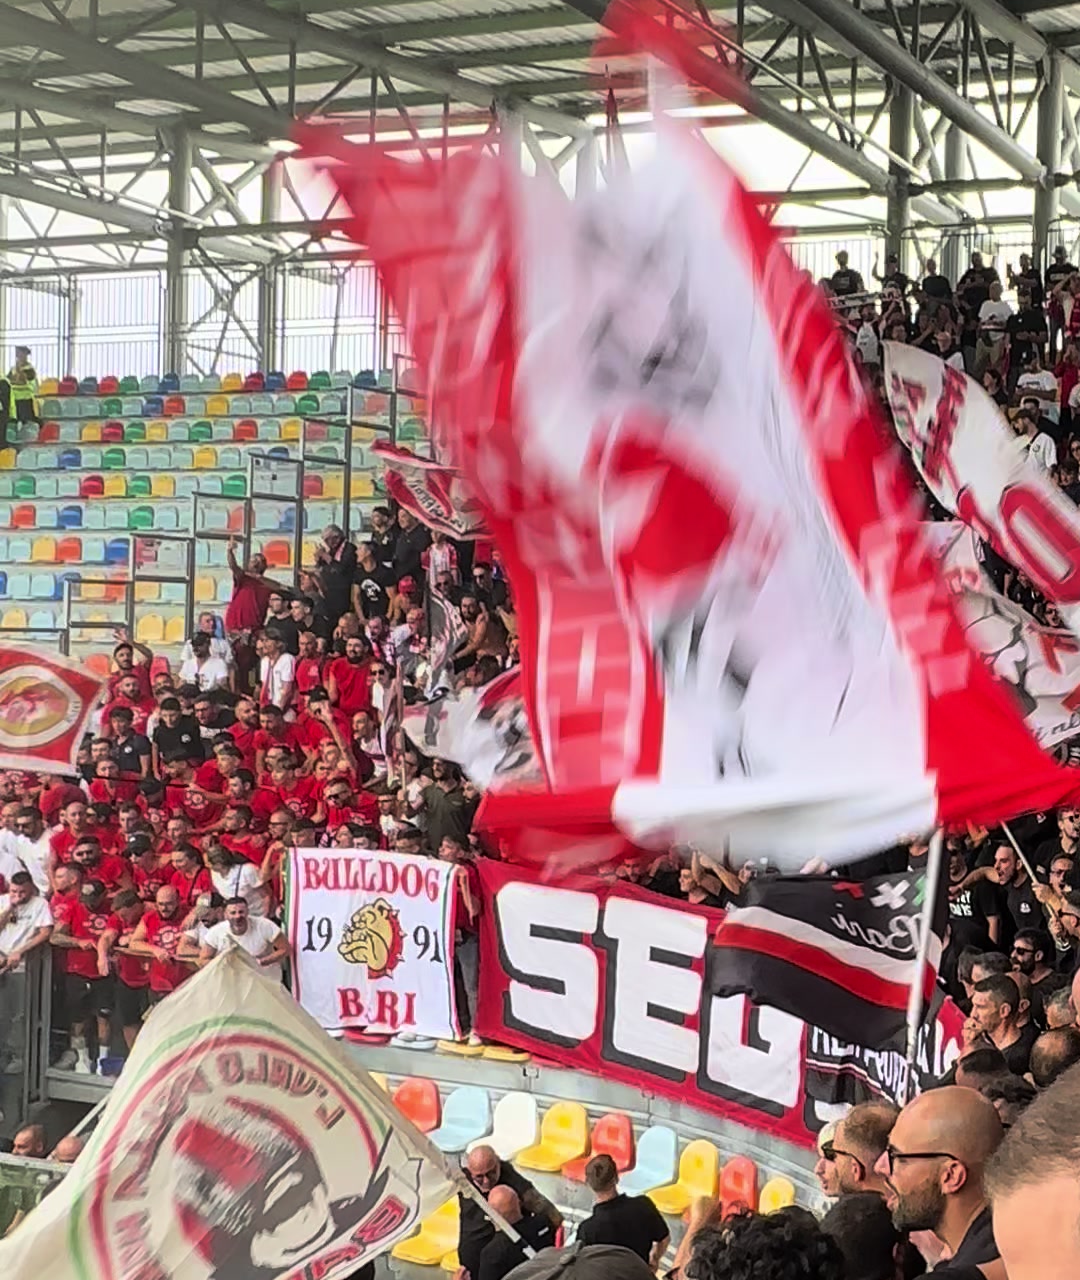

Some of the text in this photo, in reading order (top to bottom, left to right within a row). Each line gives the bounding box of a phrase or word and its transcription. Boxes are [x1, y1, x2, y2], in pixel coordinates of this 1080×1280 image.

[302, 857, 440, 903] BULLDOG
[302, 915, 333, 953] 19
[413, 925, 443, 963] 91
[337, 987, 417, 1029] BRI
[497, 881, 850, 1126] SEG
